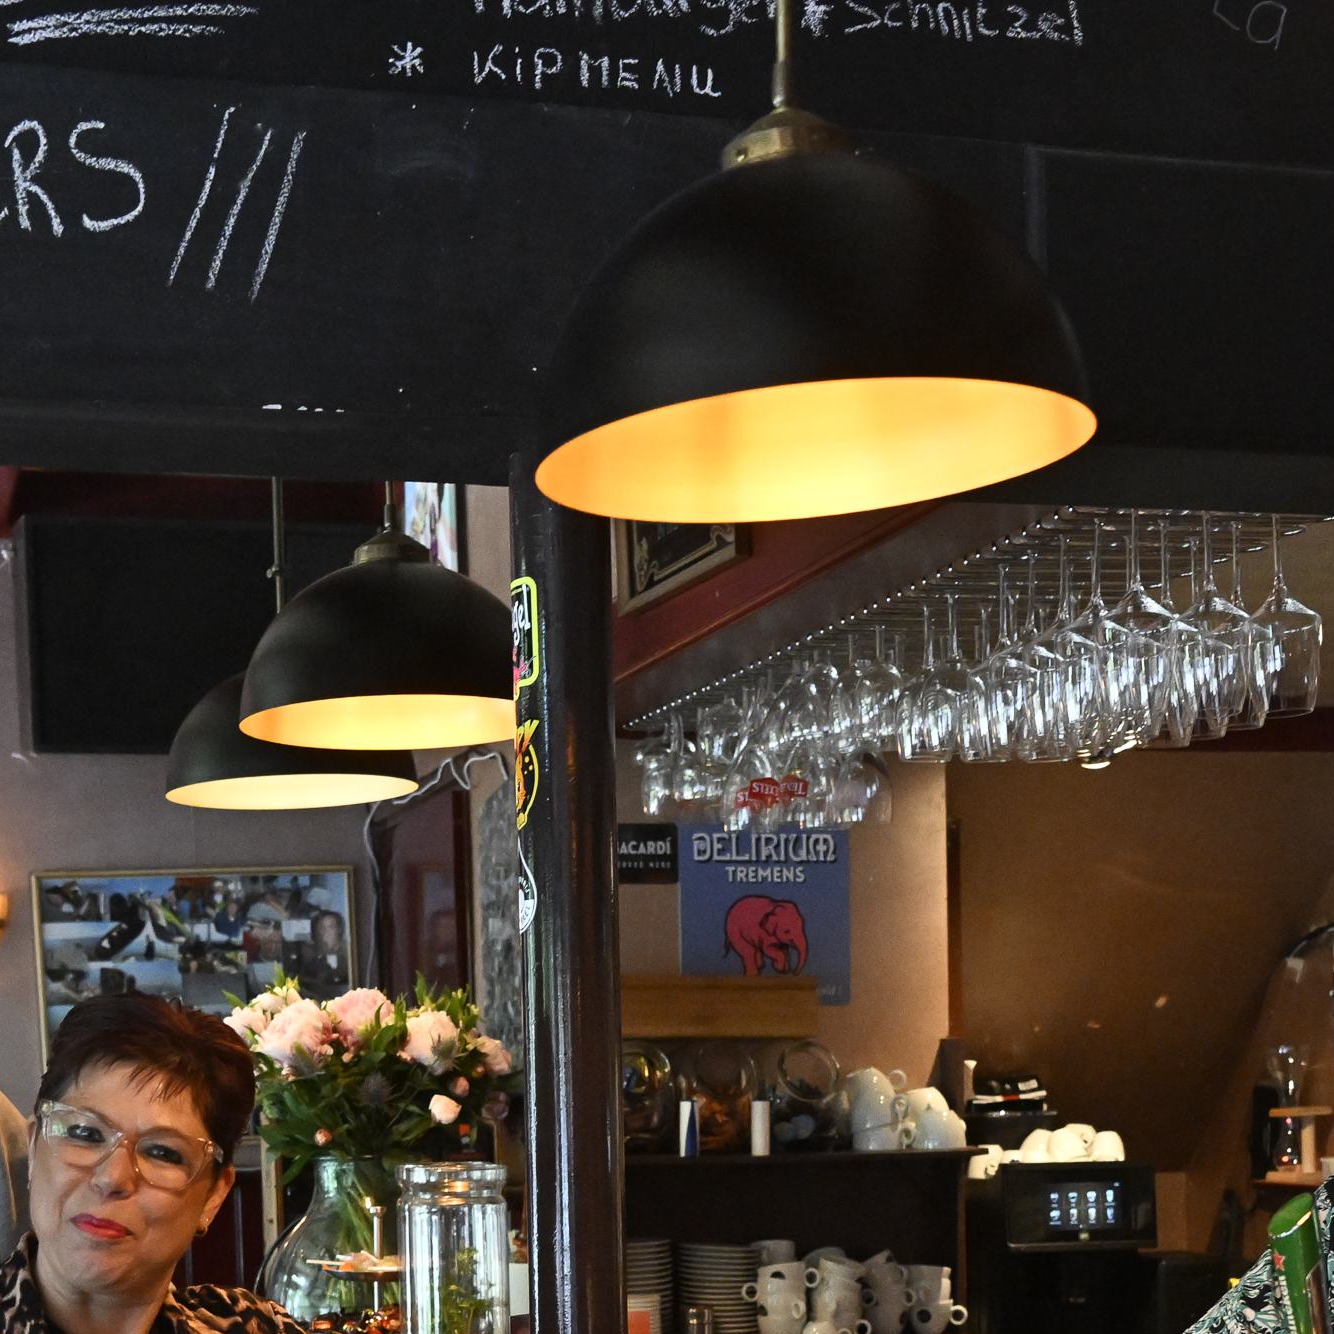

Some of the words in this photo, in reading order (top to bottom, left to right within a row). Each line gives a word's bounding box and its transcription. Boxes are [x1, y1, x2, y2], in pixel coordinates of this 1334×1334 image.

[618, 837, 672, 856] ACARDÍ
[691, 832, 837, 862] DELIRIUM
[726, 866, 806, 883] TREMENS
